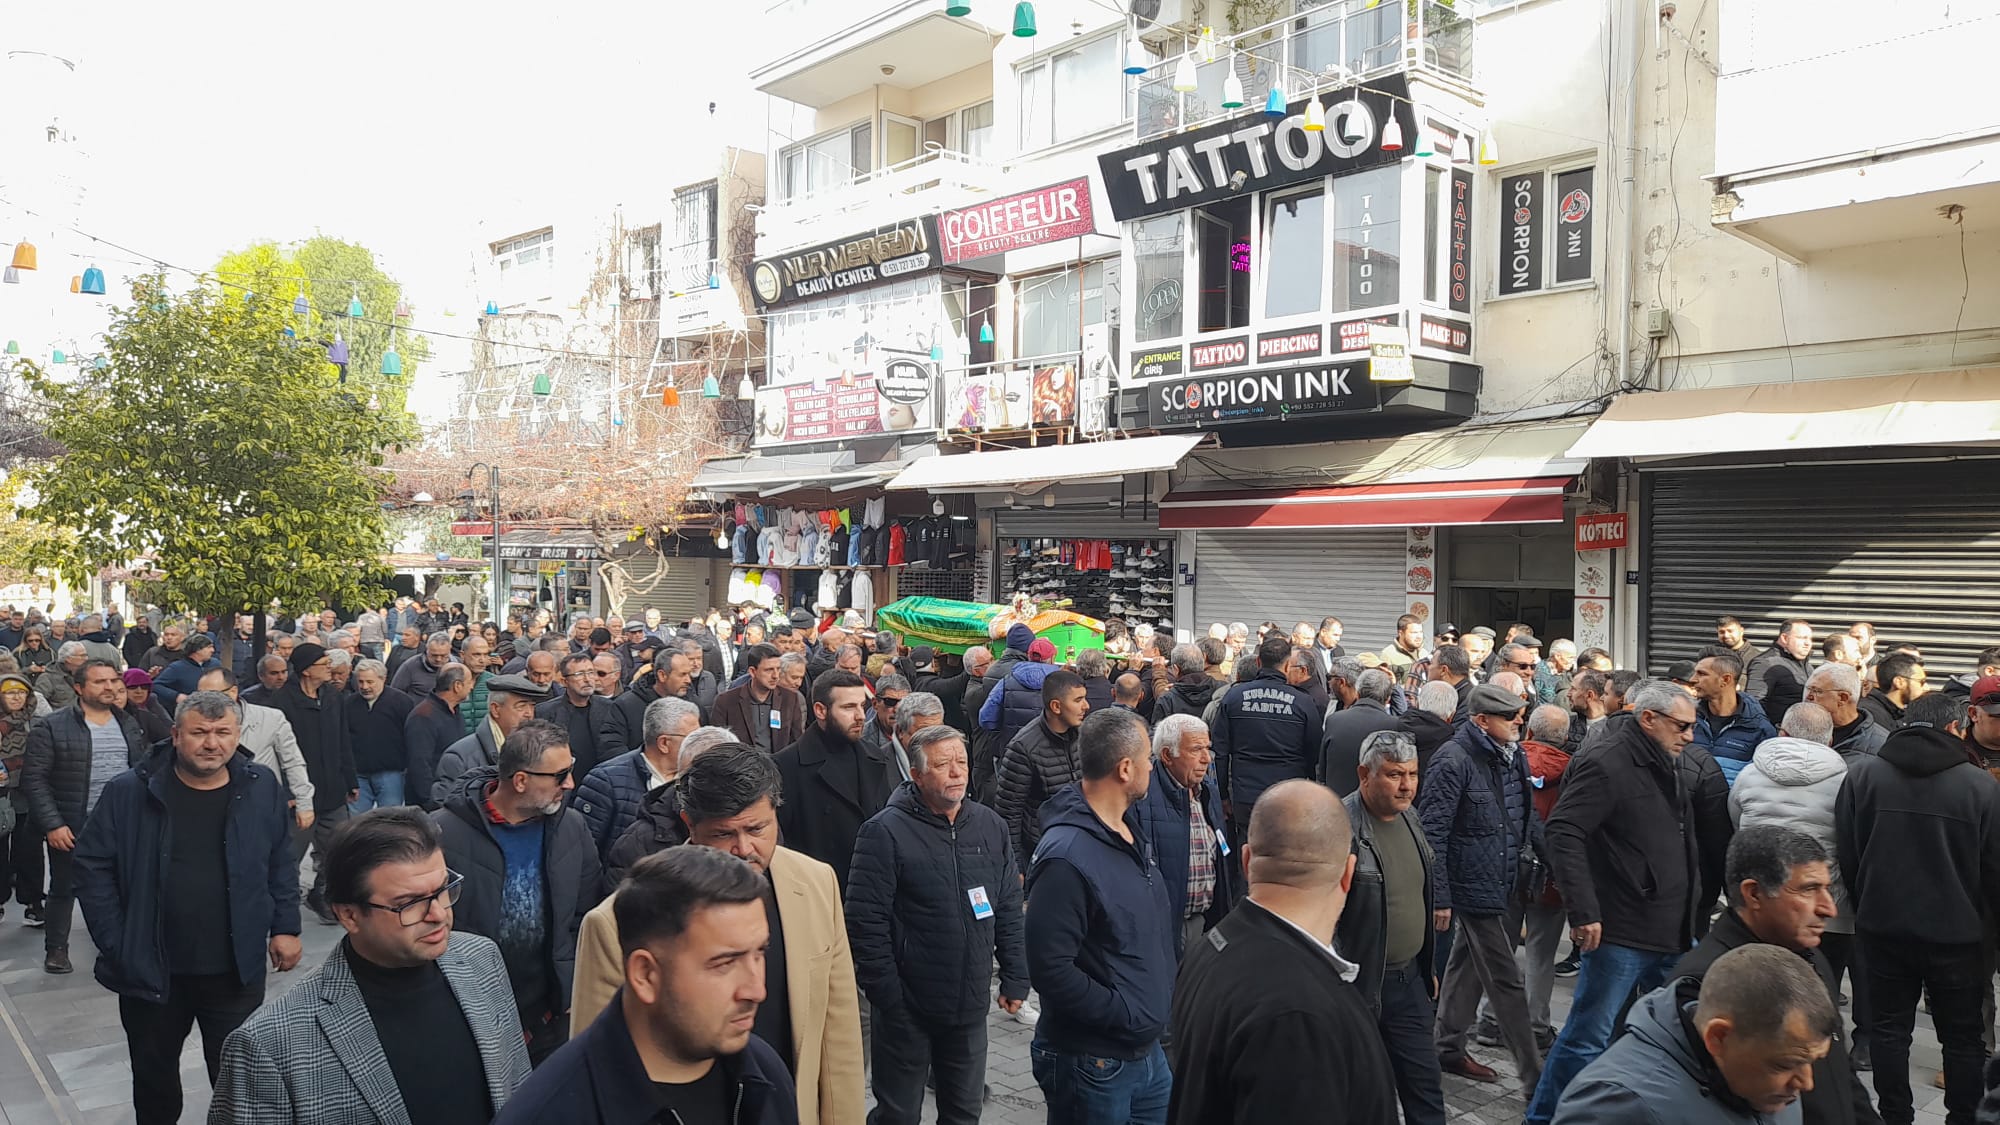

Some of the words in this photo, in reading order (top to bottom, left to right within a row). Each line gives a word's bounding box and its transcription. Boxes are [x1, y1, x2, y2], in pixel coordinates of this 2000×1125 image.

[1125, 98, 1376, 204] TATTOO
[947, 188, 1080, 243] COIFFEUR
[978, 236, 1011, 252] BEAUTY
[1359, 194, 1373, 295] TATTOO
[1452, 180, 1467, 302] TATTOO
[1567, 229, 1581, 258] INK
[796, 276, 833, 297] BEAUTY
[835, 266, 877, 288] CENTER
[1148, 283, 1179, 310] OPEN
[1259, 333, 1319, 357] PIERCING
[1422, 321, 1451, 345] MAKE
[1452, 329, 1467, 348] UP
[1144, 350, 1181, 364] ENTRANCE
[1193, 341, 1246, 366] TATTOO
[1294, 367, 1352, 399] INK
[1580, 516, 1624, 542] KÖFTECİ
[541, 548, 568, 558] IRISH
[575, 548, 598, 558] PUB
[1241, 701, 1293, 715] ZABITA
